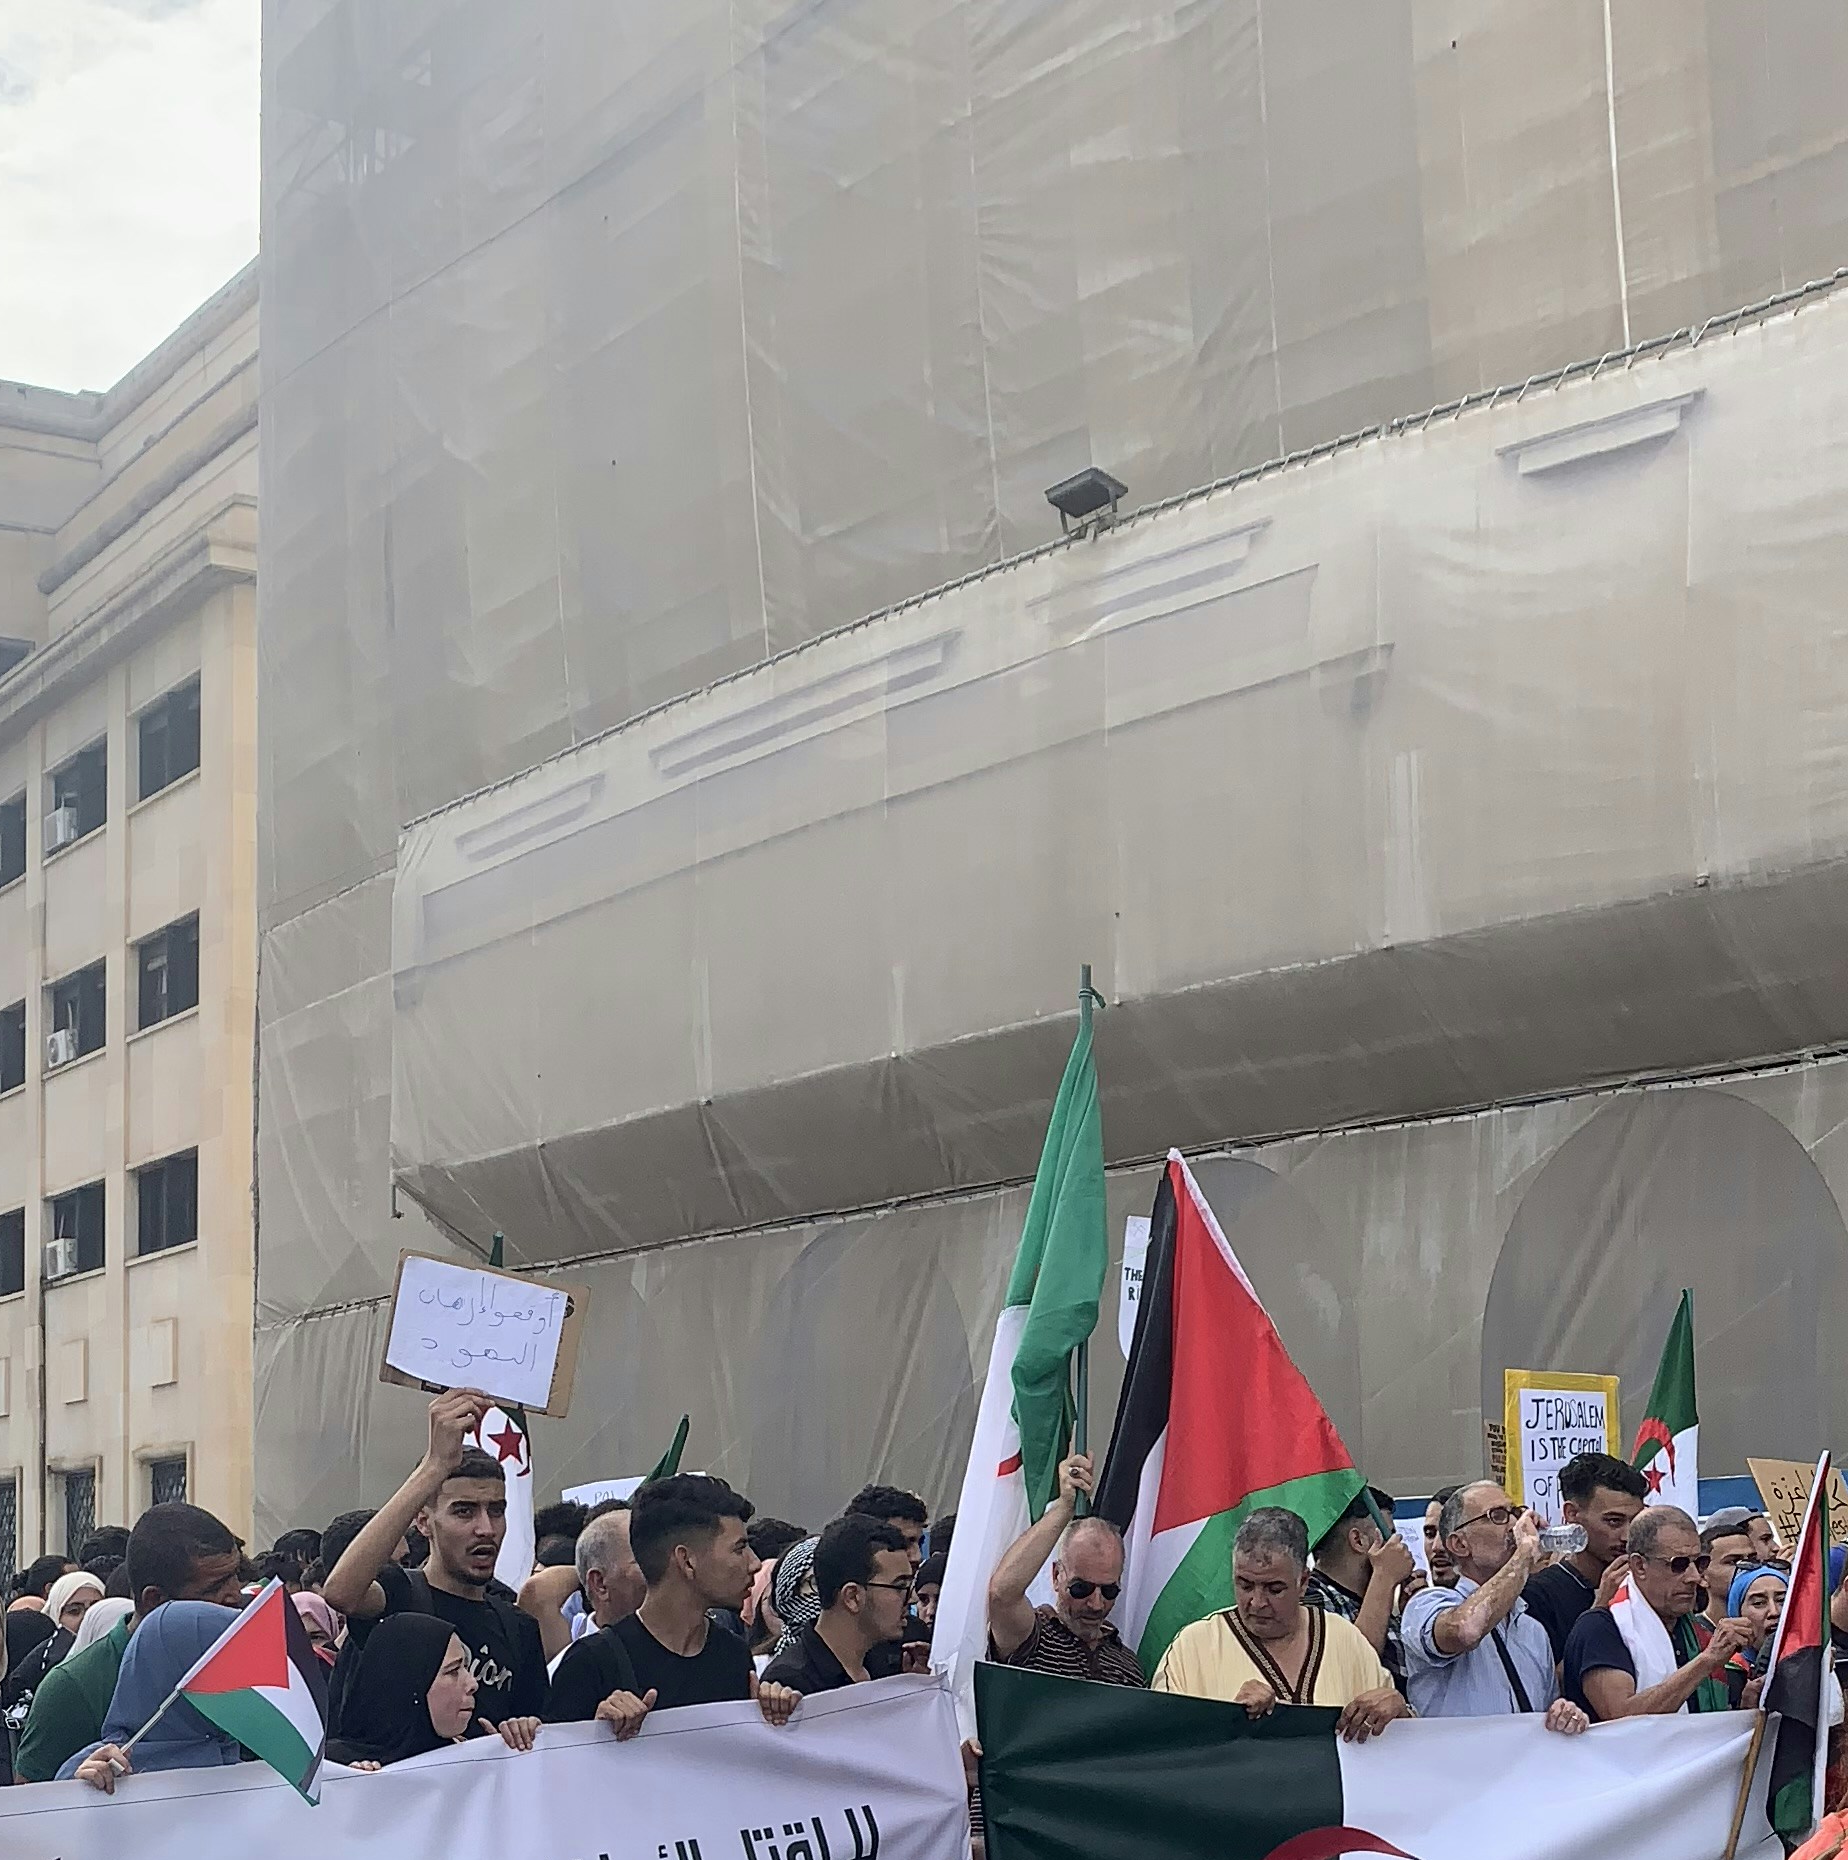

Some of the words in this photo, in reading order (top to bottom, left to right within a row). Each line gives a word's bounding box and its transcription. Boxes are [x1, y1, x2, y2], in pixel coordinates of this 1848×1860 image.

[1525, 1397, 1606, 1431] JERUSALEM
[1531, 1437, 1549, 1462] IS
[1549, 1436, 1567, 1460] THE
[1533, 1476, 1553, 1498] OF
